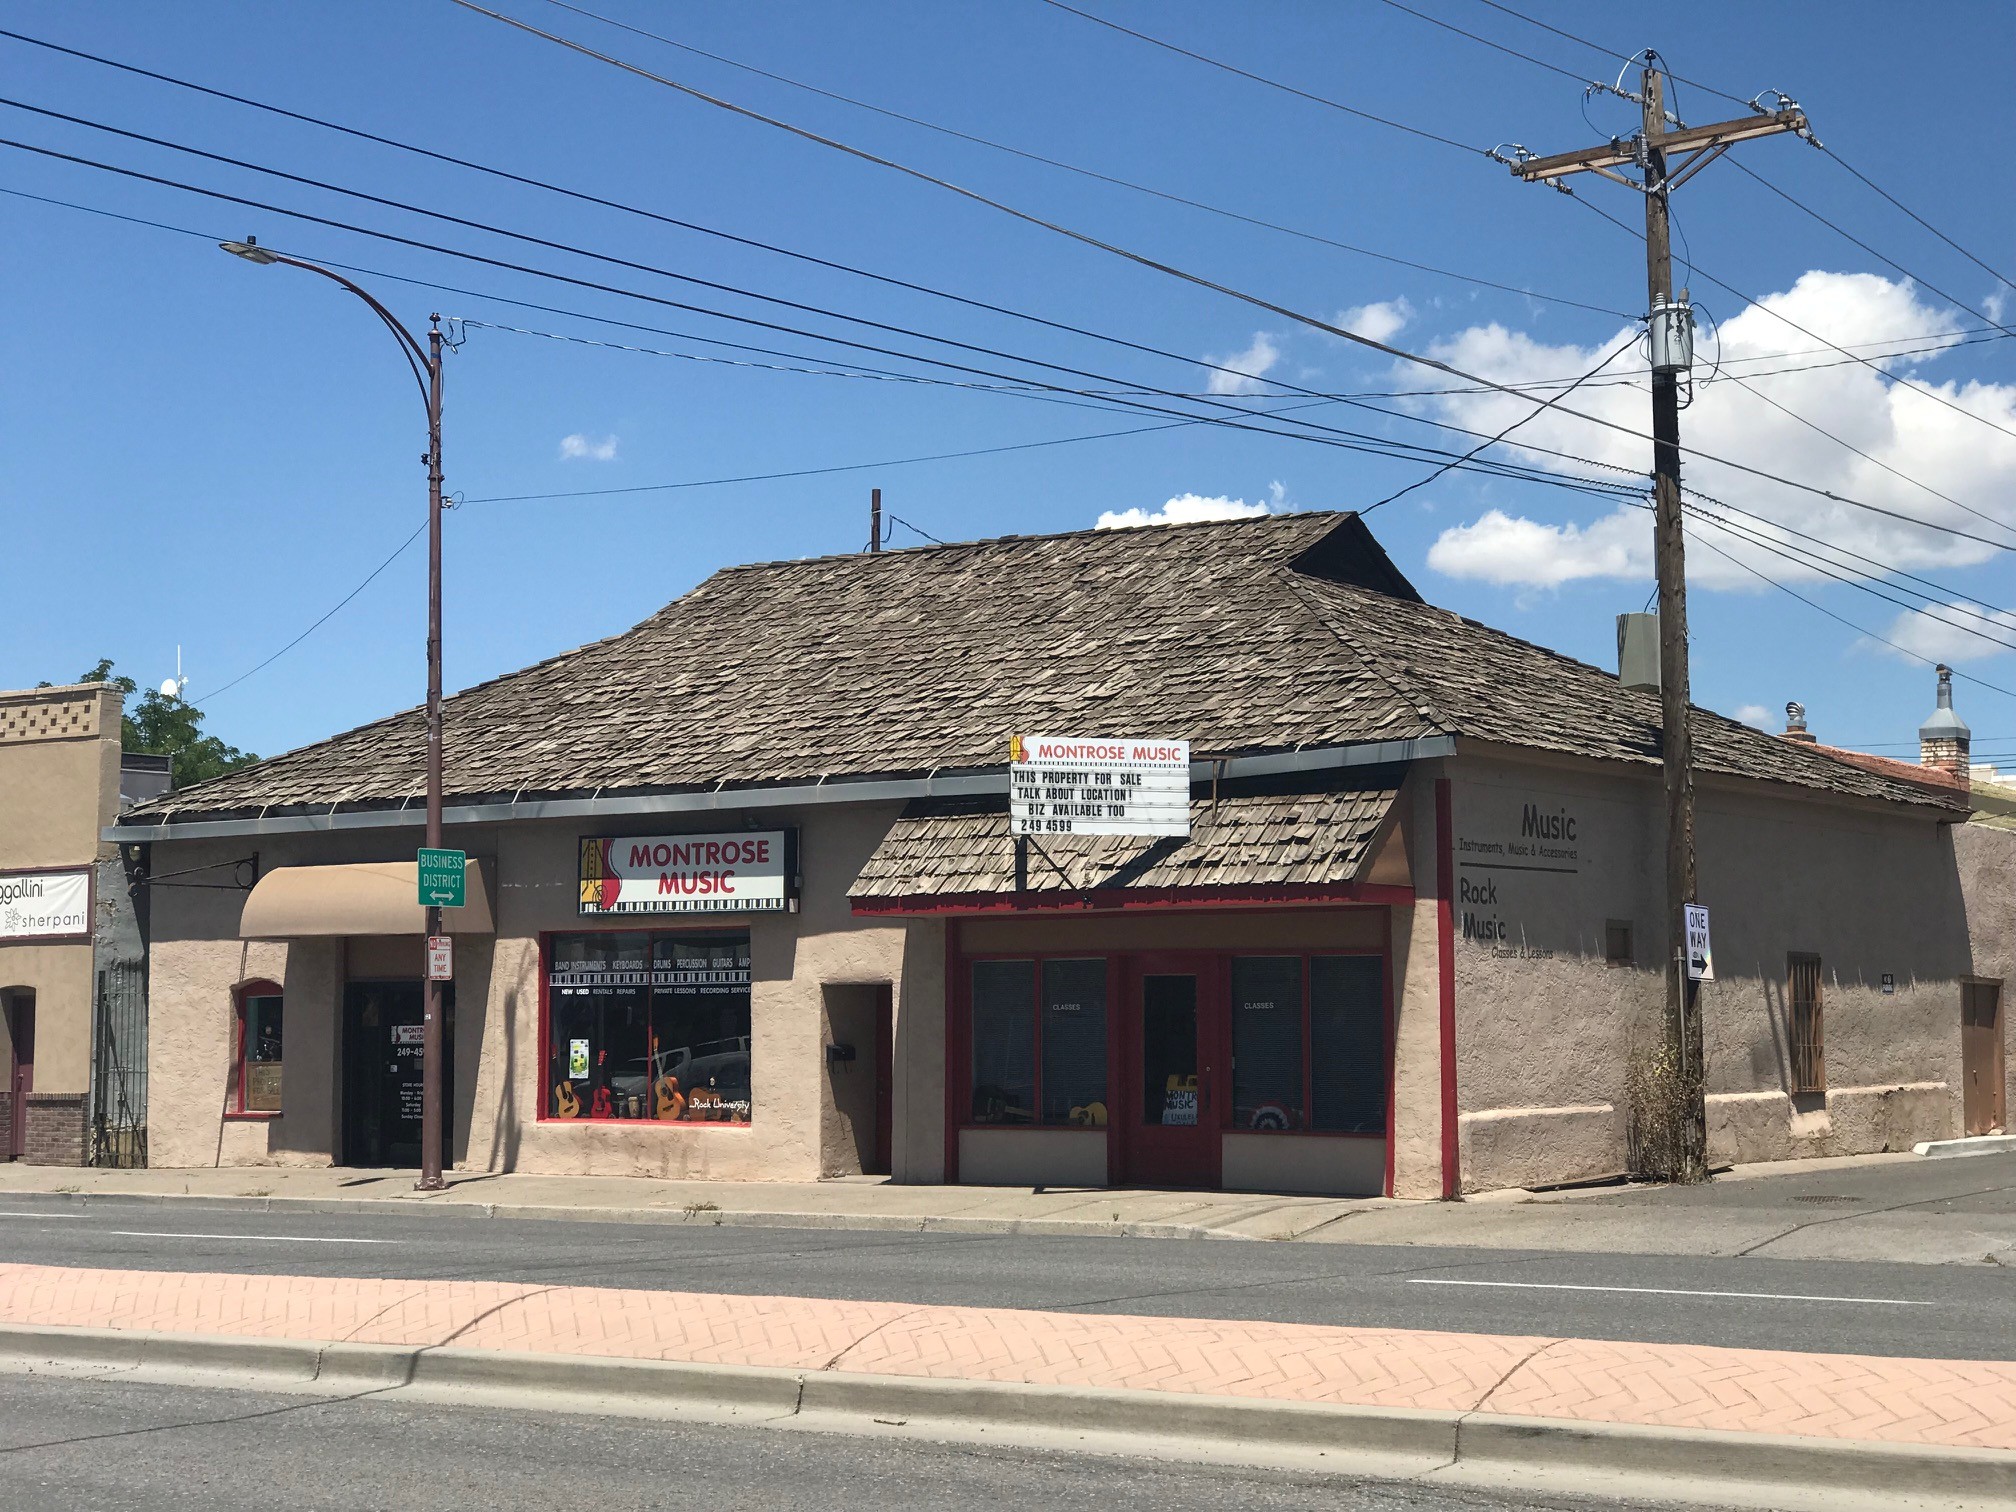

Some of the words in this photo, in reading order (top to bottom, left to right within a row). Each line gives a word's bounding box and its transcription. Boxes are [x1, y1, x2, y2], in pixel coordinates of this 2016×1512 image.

[1038, 744, 1125, 760] MONTROSE
[1133, 746, 1181, 761] MUSIC
[1013, 770, 1036, 783] THIS
[1042, 771, 1089, 784] PROPERTY
[1095, 773, 1112, 785] FOR
[1120, 773, 1142, 786] SALE
[1017, 787, 1041, 800] TALK
[1045, 788, 1075, 800] ABOUT
[1081, 789, 1132, 802] LOCATION!
[1028, 803, 1045, 815] BIZ
[1052, 804, 1102, 817] AVAILABLE
[1107, 805, 1125, 817] TOO
[1021, 819, 1042, 832] 249
[1045, 820, 1072, 832] 4599
[1522, 803, 1577, 841] Music
[629, 840, 770, 868] MONTROSE
[1459, 837, 1505, 857] Instruments,
[1508, 842, 1528, 857] Music
[1531, 843, 1536, 857] &
[1538, 845, 1578, 860] Accessories
[421, 854, 463, 869] BUSINESS
[423, 874, 461, 888] DISTRICT
[658, 870, 735, 894] MUSIC
[1460, 876, 1497, 905] Rock
[22, 911, 85, 929] sherpani
[1463, 912, 1507, 940] Music
[1690, 911, 1705, 929] ONE
[1690, 931, 1706, 949] WAY
[434, 953, 446, 962] ANY
[1527, 947, 1554, 960] Lessons
[434, 964, 447, 973] TIME
[555, 960, 570, 971] BAND
[571, 960, 607, 971] INSTRUMENTS
[612, 960, 643, 970] KEYBOARDS
[653, 959, 671, 969] DRUMS
[676, 958, 707, 969] PERCUSSION
[712, 957, 733, 968] GUITARS
[1053, 1003, 1081, 1011] CLASSES
[1244, 1002, 1274, 1010] CLASSES
[397, 1048, 424, 1057] 249-45
[689, 1097, 711, 1109] Rock
[713, 1097, 750, 1116] University
[1165, 1100, 1194, 1110] MUSIC
